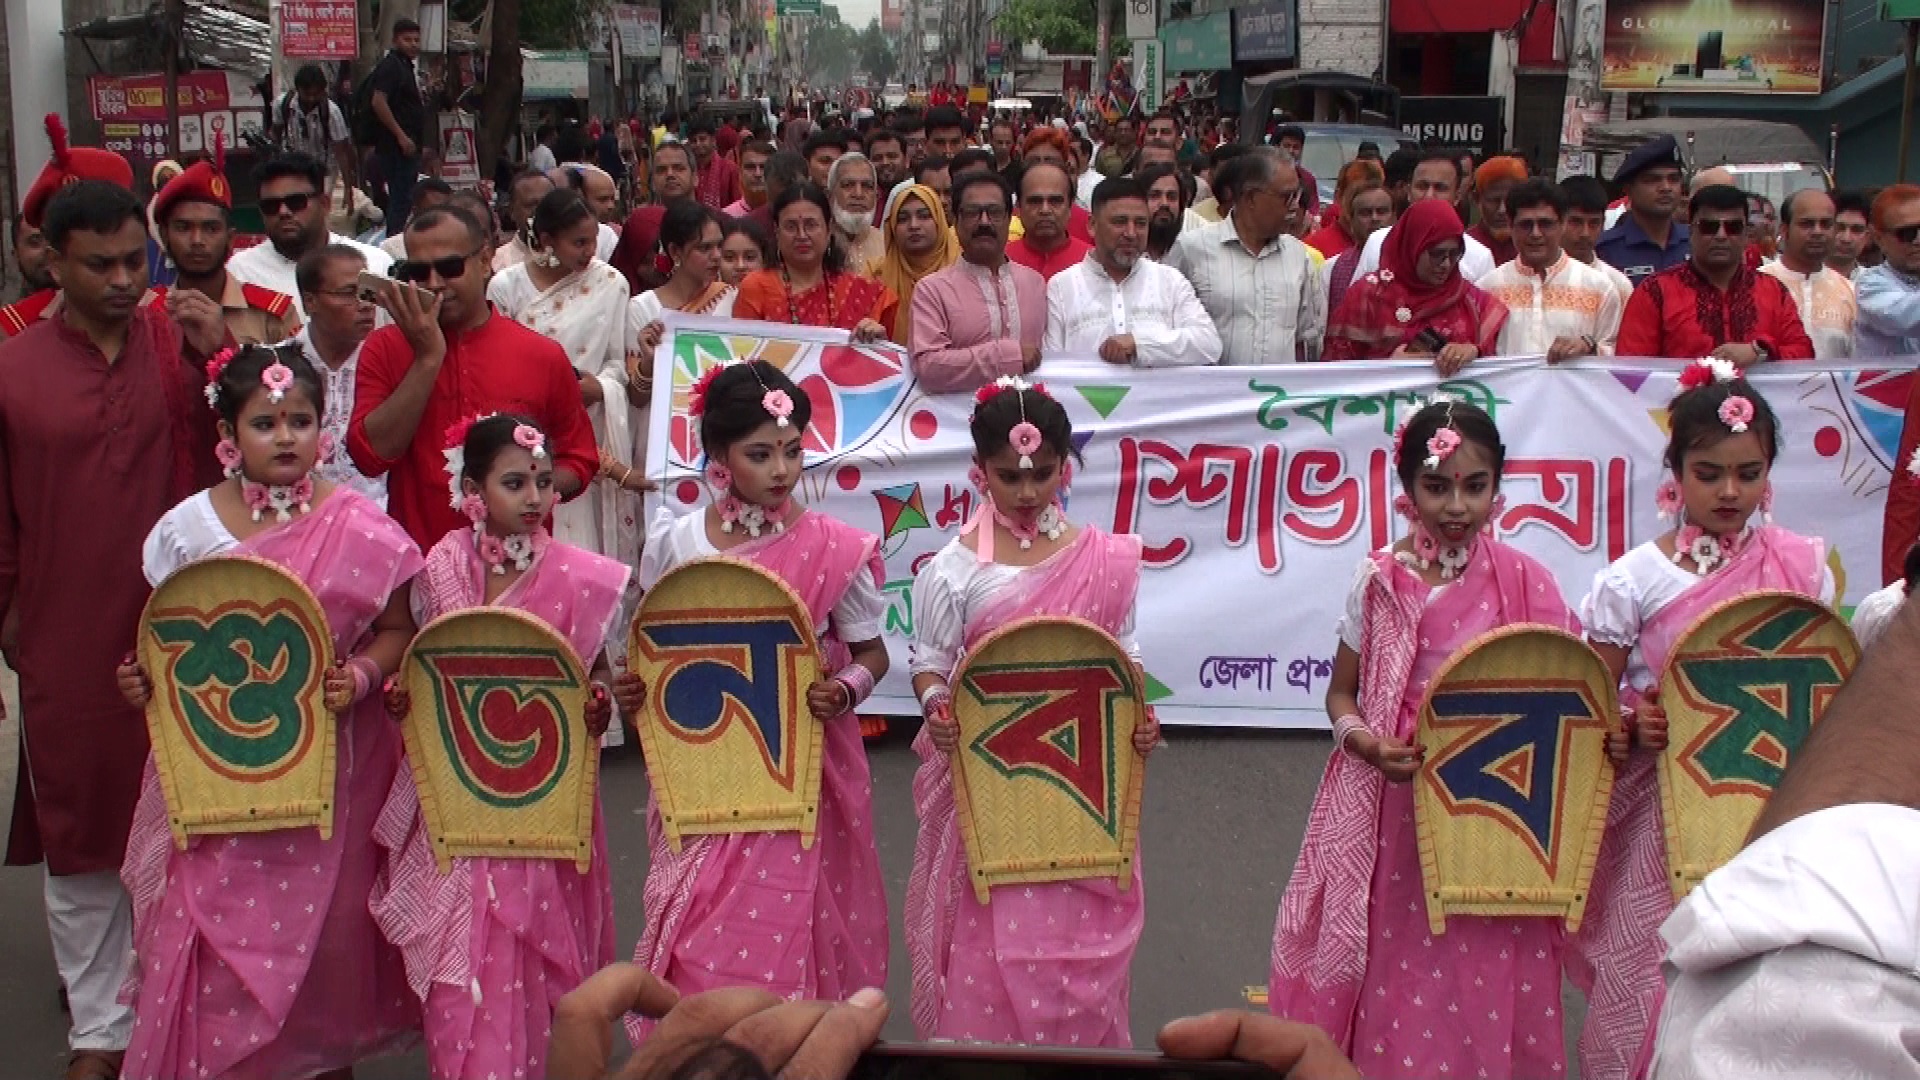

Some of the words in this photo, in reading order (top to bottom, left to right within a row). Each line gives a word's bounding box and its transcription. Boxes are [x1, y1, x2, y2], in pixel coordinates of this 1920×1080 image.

[1402, 123, 1484, 141] MSUNG
[640, 614, 808, 777] ন
[968, 663, 1129, 827] ব
[1199, 653, 1277, 692] জেলা
[1428, 686, 1599, 868] ব
